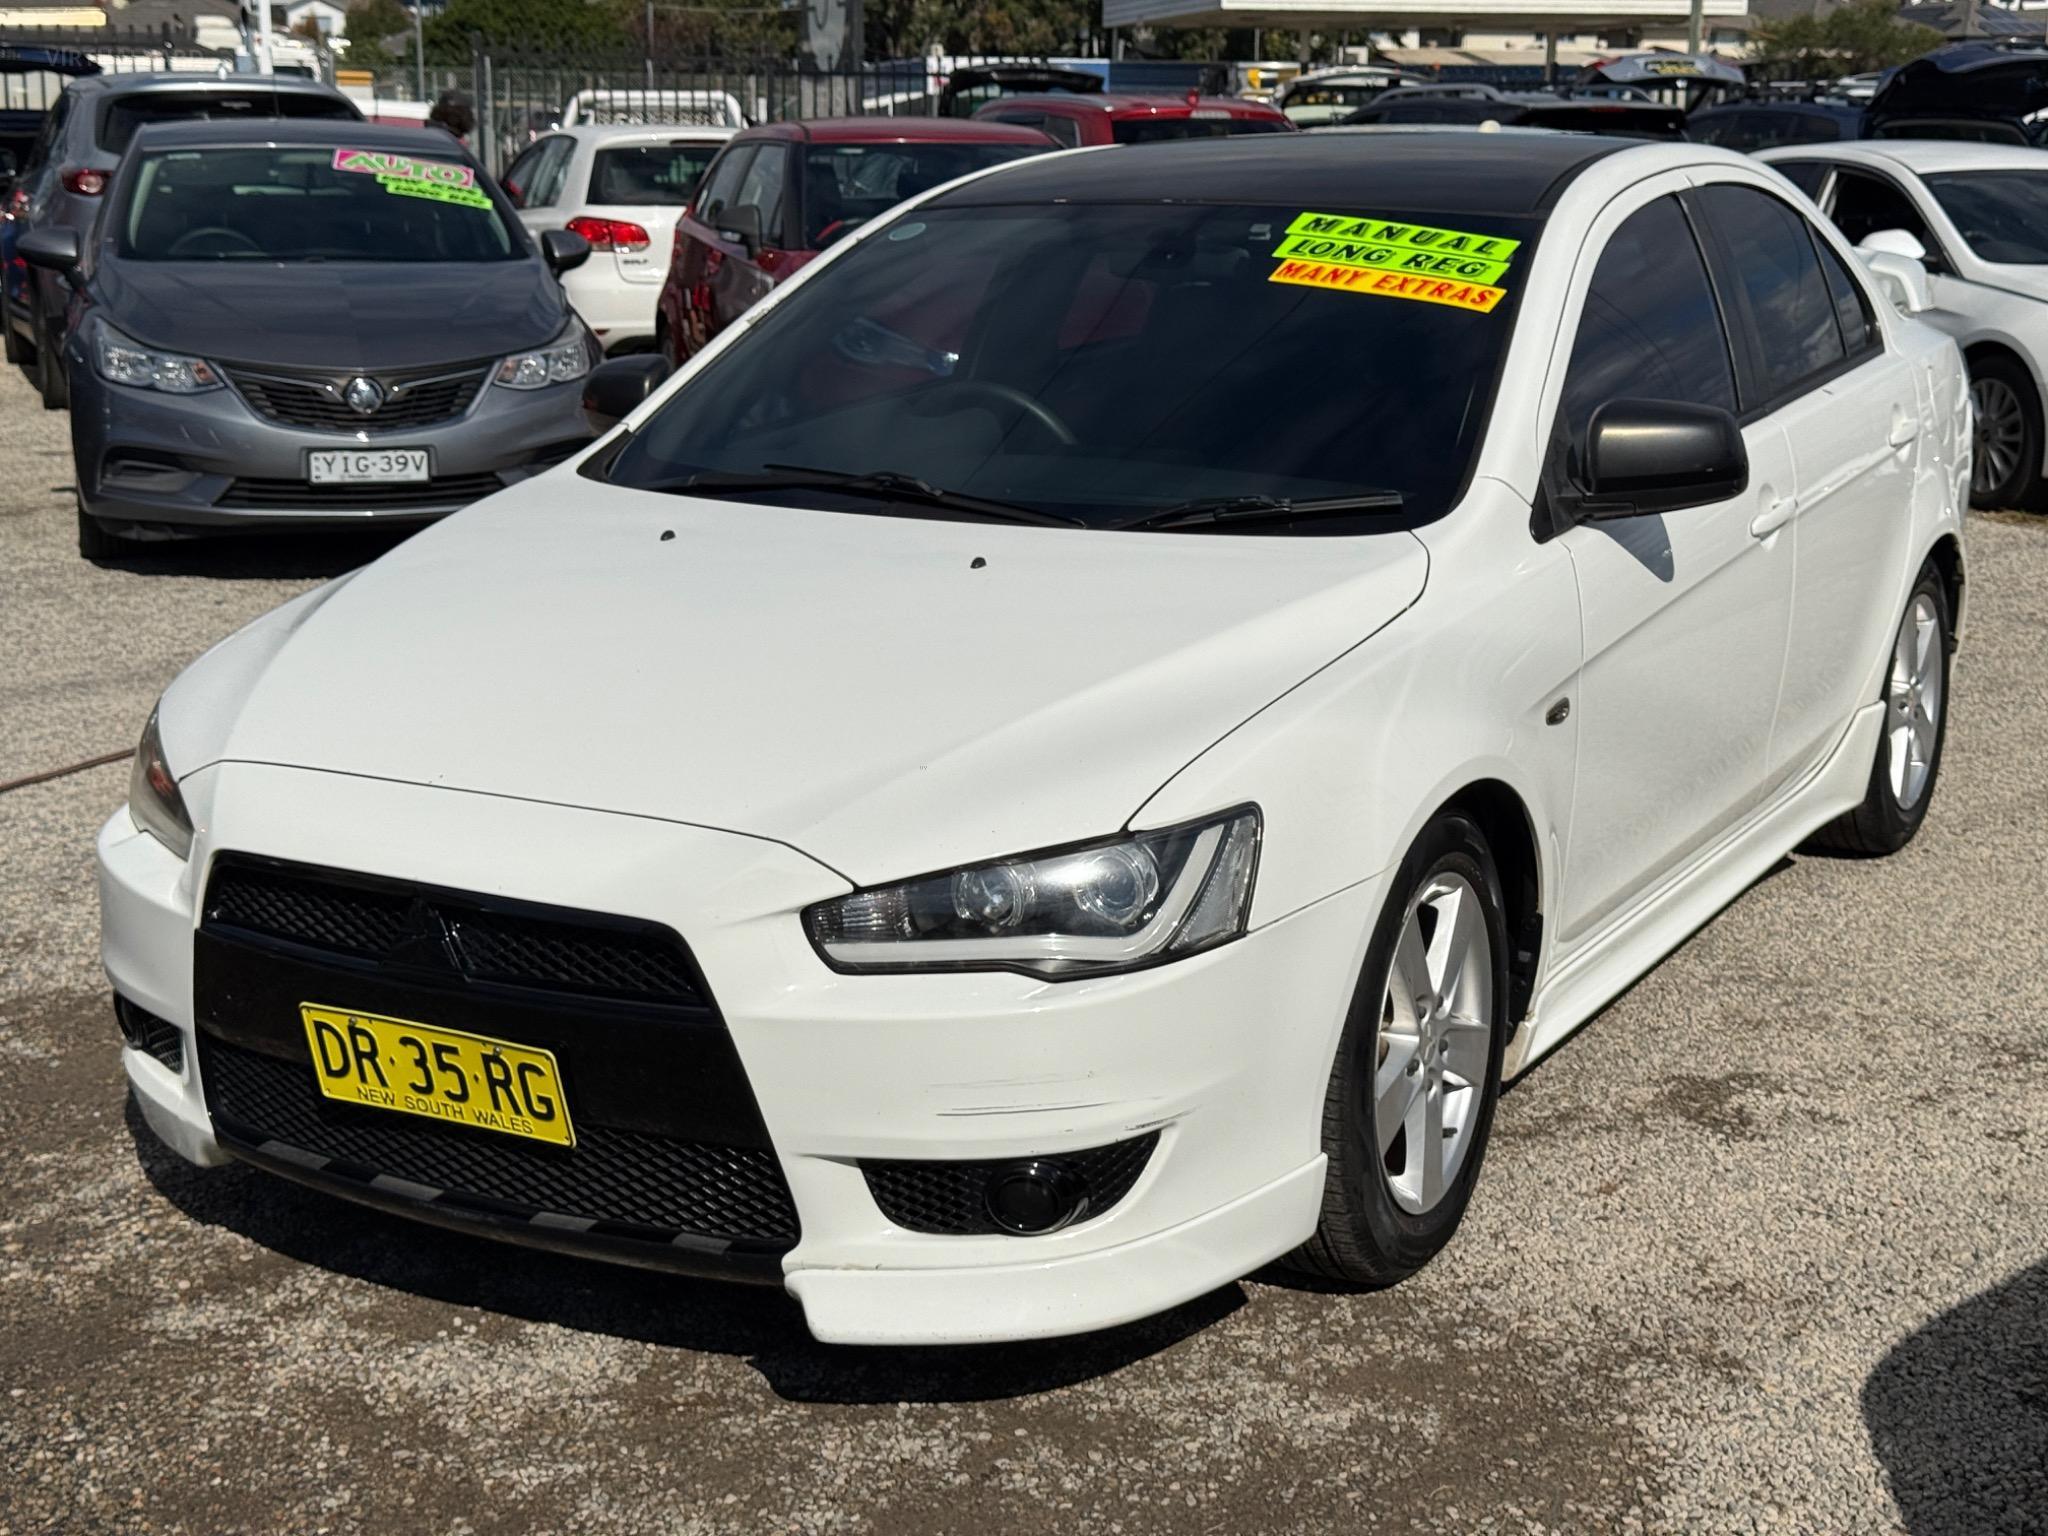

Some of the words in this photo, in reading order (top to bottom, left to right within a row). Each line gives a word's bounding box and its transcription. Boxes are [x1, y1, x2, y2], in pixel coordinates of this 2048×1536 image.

[341, 152, 468, 184] AUTO
[1302, 217, 1502, 257] MANUAL
[1288, 239, 1396, 263] LONG
[1402, 254, 1490, 278] REG
[1276, 262, 1369, 286] MANY
[1371, 274, 1497, 306] EXTRAS
[356, 1085, 396, 1106] NEW
[404, 1096, 465, 1120] SOUTH
[472, 1108, 534, 1134] WALES
